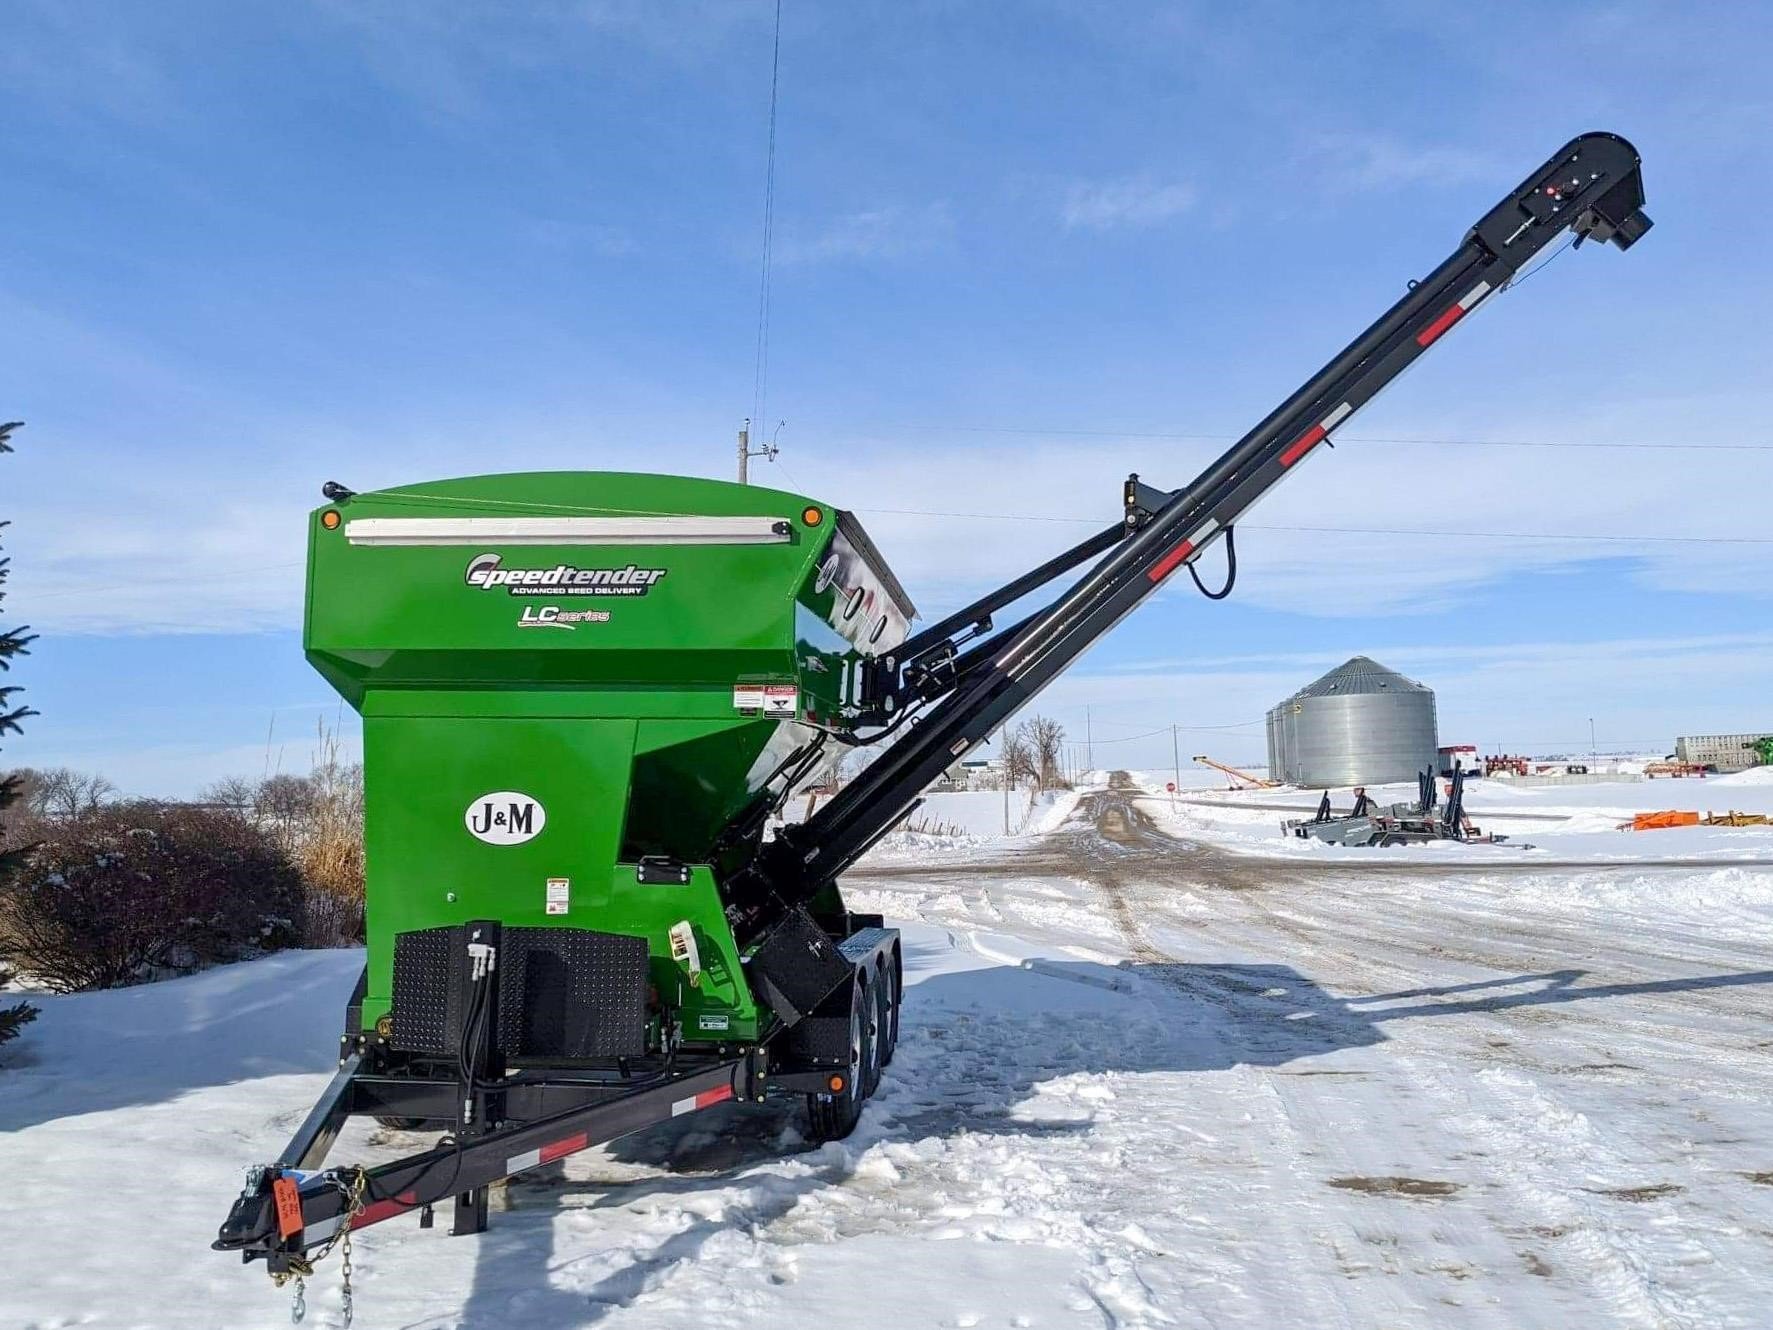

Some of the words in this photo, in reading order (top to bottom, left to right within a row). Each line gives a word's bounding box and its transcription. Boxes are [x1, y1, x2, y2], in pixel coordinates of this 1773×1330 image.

[512, 587, 566, 595] ADVANCED
[567, 587, 593, 595] SEED
[595, 587, 642, 595] DELIVERY
[472, 803, 534, 834] J&M
